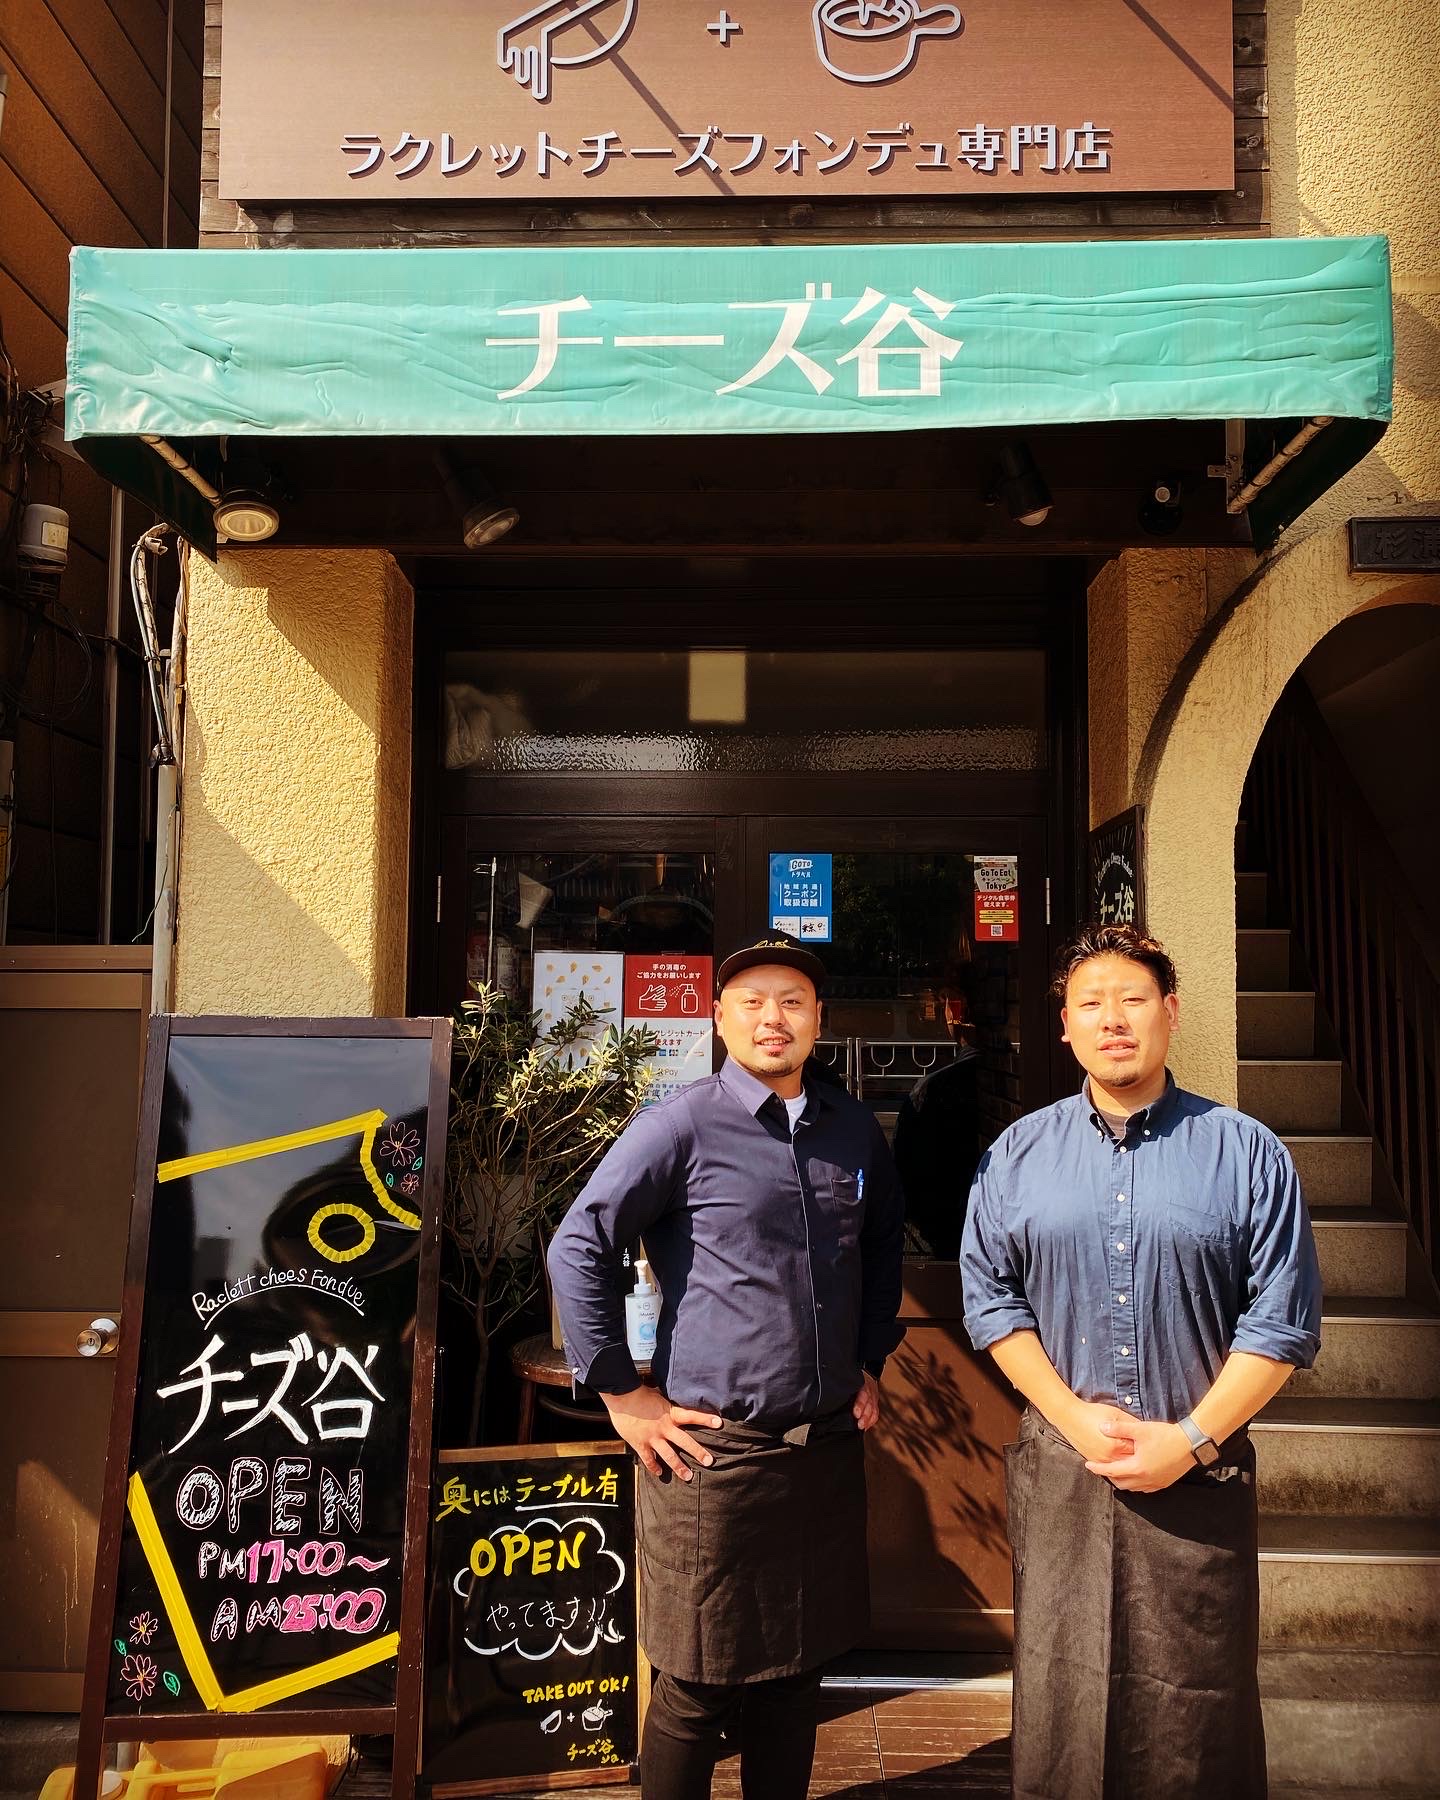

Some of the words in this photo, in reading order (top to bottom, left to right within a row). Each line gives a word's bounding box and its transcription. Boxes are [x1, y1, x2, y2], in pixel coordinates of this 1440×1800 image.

[342, 122, 1112, 178] ラクレットチーズフォンデュ専門店
[485, 281, 963, 401] チーズ谷
[783, 890, 818, 898] クーポン
[985, 882, 1007, 891] Tokyo
[783, 898, 818, 907] 取扱店舗
[636, 971, 702, 979] ご協力をお願いします
[652, 963, 687, 971] 手の消毒の
[191, 1273, 257, 1321] Raclett
[310, 1269, 366, 1307] Fondue
[156, 1332, 386, 1455] チーズ谷
[175, 1456, 364, 1536] OPEN
[470, 1531, 587, 1577] OPEN
[522, 1684, 565, 1704] TAKE
[567, 1680, 595, 1698] OUT
[598, 1675, 630, 1693] OK!
[566, 1738, 615, 1762] チーズ谷
